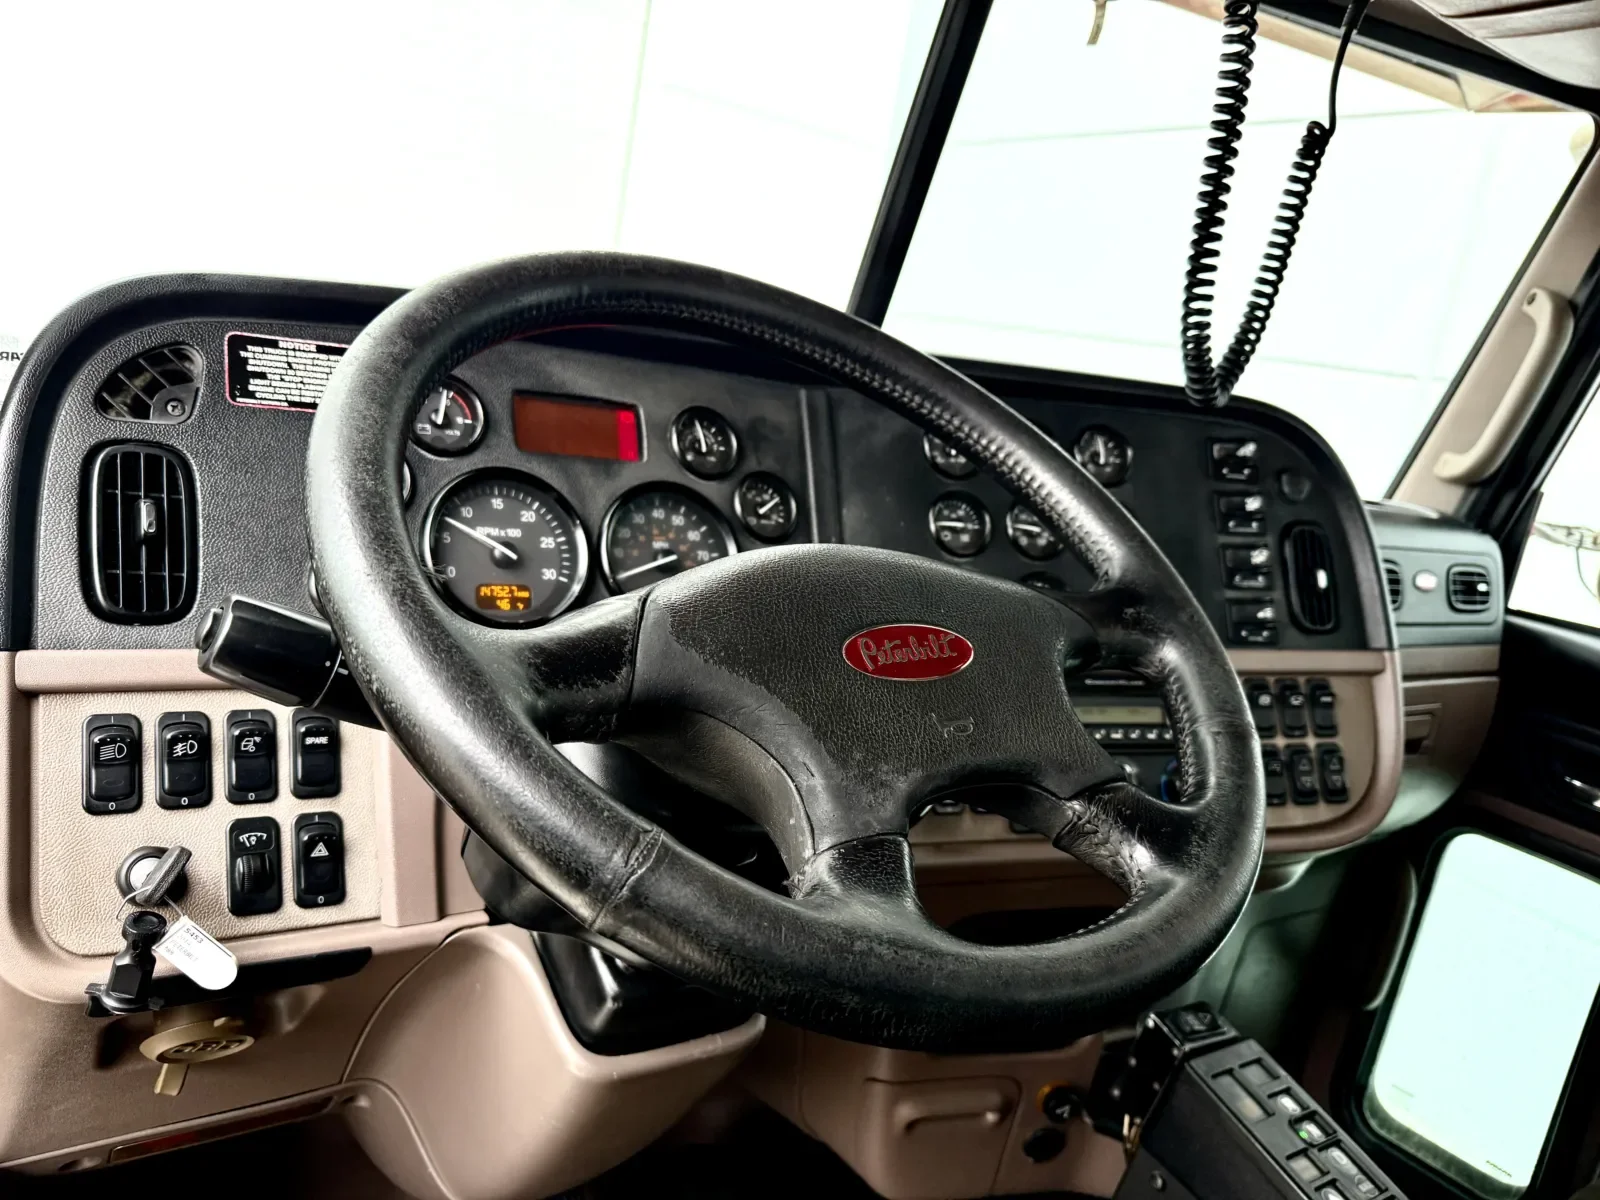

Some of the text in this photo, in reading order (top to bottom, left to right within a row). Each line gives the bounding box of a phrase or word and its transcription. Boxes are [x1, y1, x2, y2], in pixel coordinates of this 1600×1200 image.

[279, 341, 317, 352] NOTICE
[264, 347, 287, 355] TRUCK
[295, 351, 328, 360] EQUIPPED
[288, 357, 313, 365] ENGINE
[491, 498, 504, 510] 15
[461, 507, 473, 519] 10
[520, 511, 536, 523] 20
[652, 508, 665, 519] 40
[443, 532, 451, 543] 5
[476, 526, 500, 537] RPM
[540, 537, 556, 549] 25
[697, 550, 710, 562] 70
[447, 566, 456, 578] 0
[541, 568, 557, 581] 30
[859, 634, 958, 672] Peterbilt
[304, 736, 329, 746] SPARE
